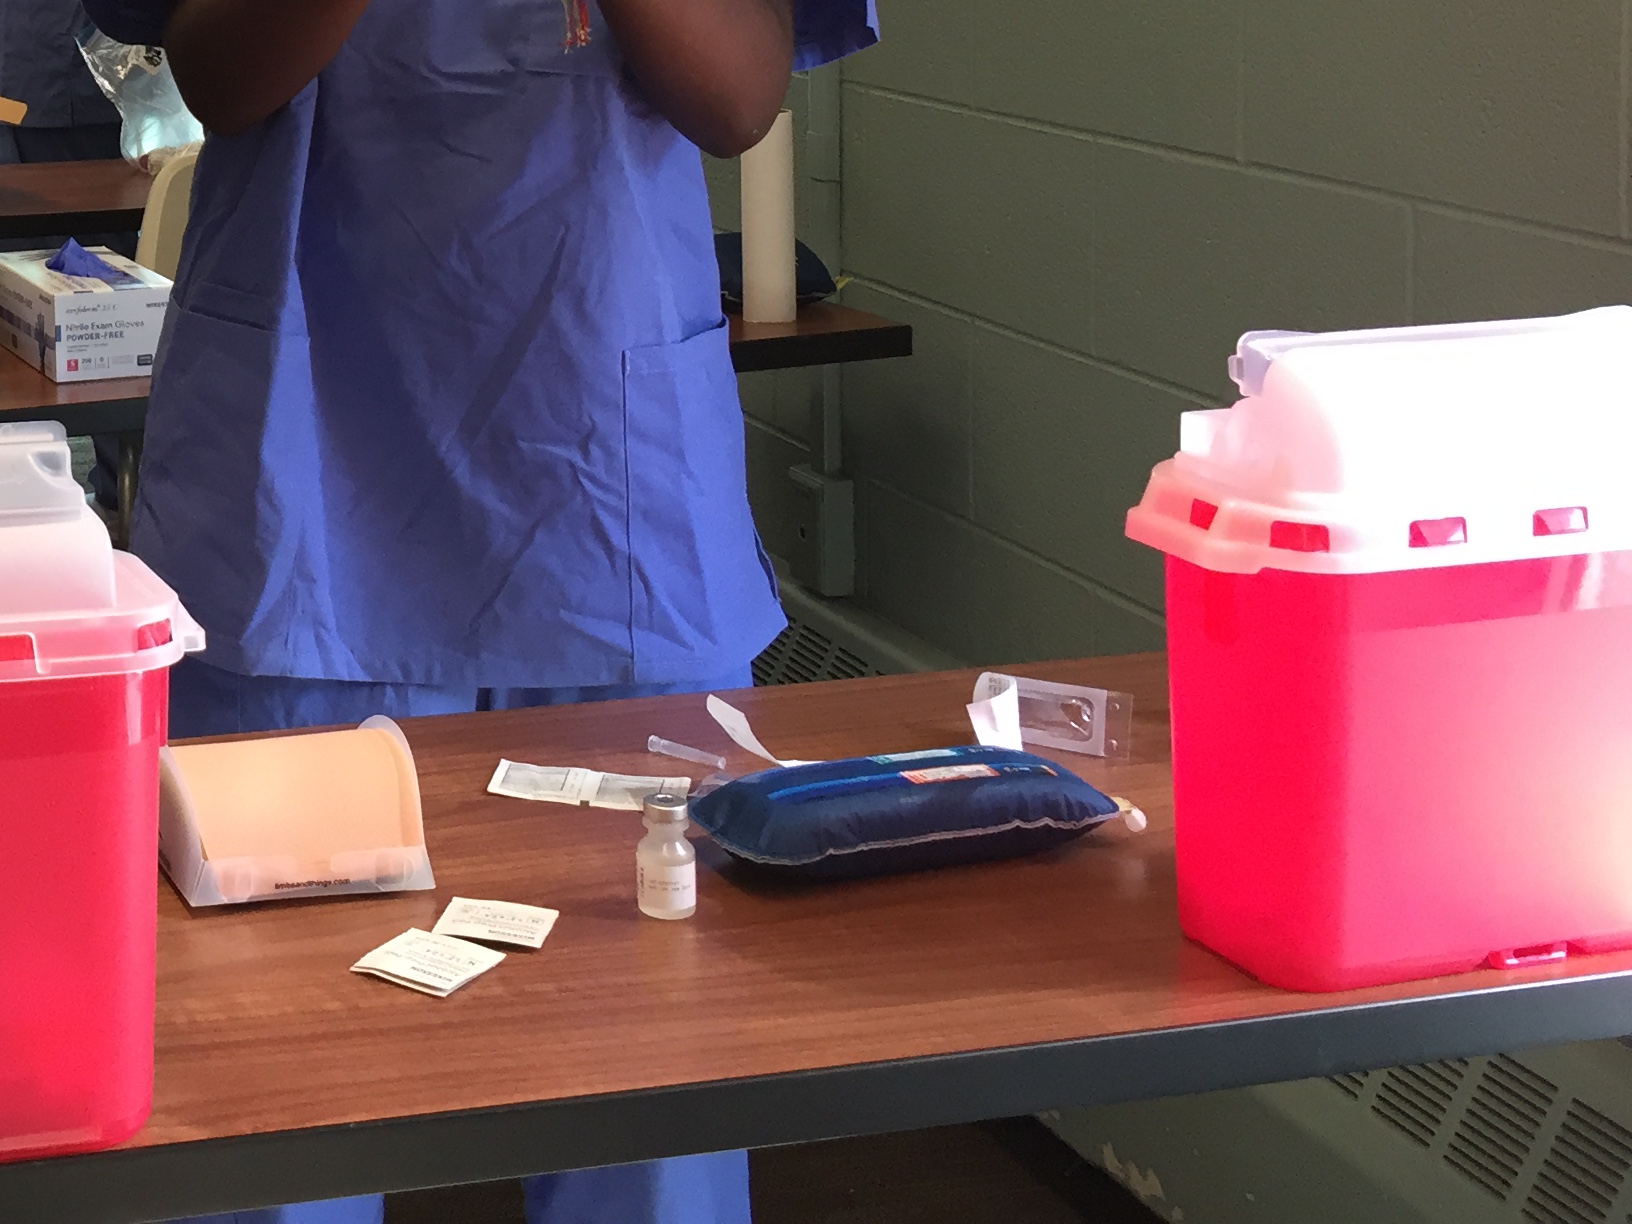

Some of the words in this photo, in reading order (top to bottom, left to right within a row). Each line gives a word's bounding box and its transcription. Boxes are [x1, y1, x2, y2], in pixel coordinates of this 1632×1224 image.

[66, 323, 89, 332] Nitrile
[91, 321, 113, 330] Exam
[115, 319, 144, 328] Gloves
[66, 330, 124, 342] POWDER-FREE
